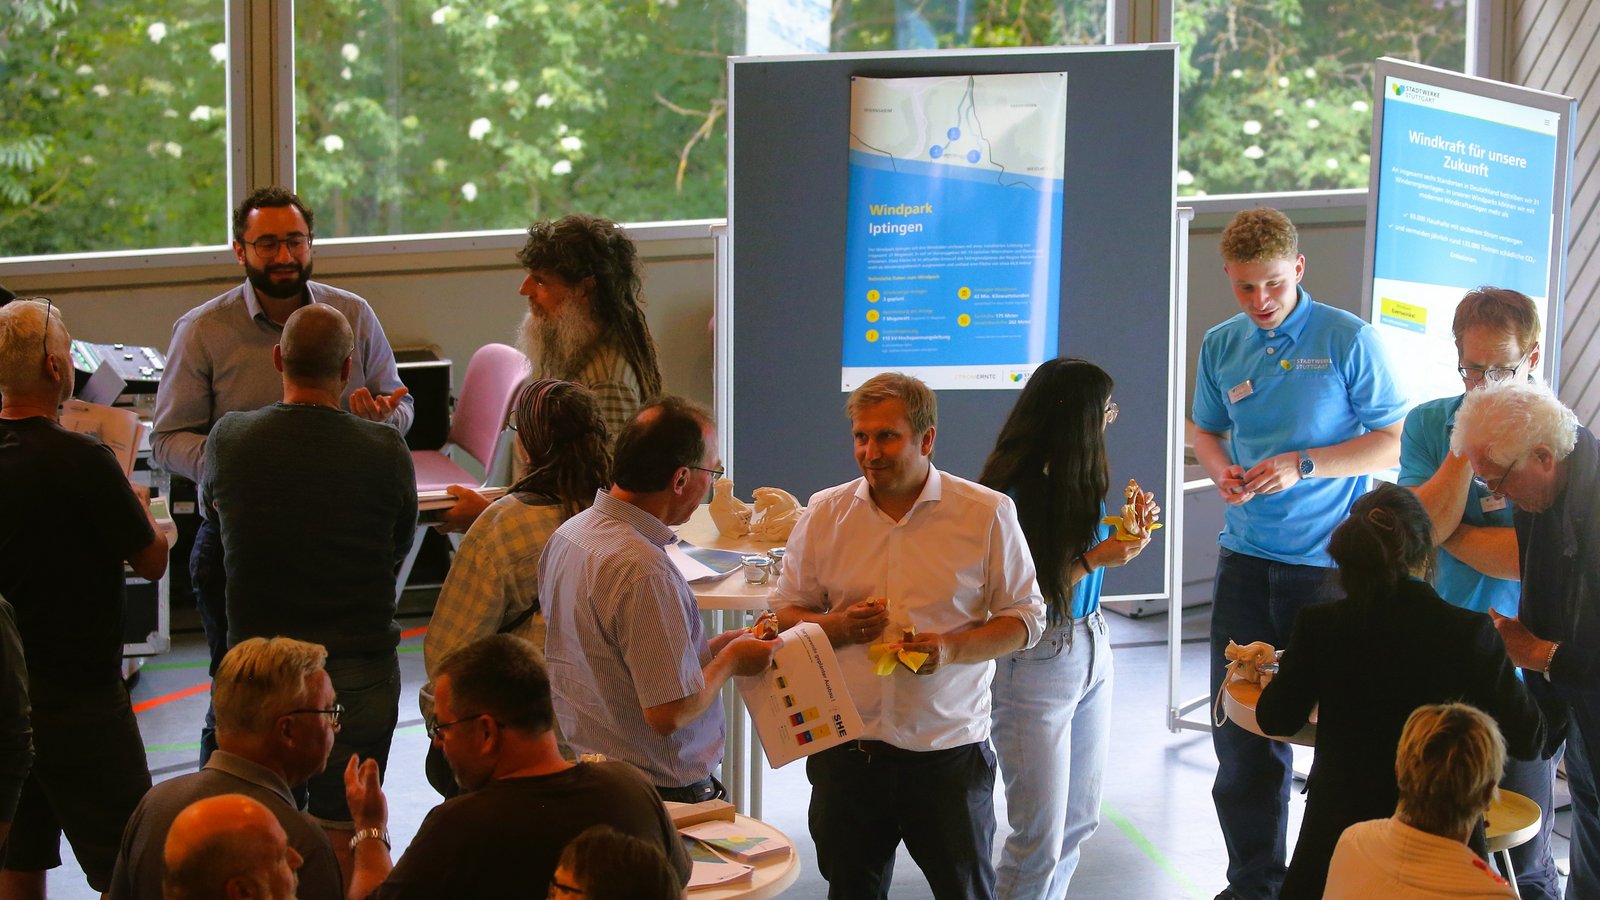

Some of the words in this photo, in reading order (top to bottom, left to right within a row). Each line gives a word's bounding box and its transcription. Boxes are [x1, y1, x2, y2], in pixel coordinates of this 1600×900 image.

[1406, 86, 1440, 98] STADTWERKE
[1406, 92, 1435, 103] STUTTGART
[1409, 129, 1466, 155] Windkraft
[1468, 143, 1486, 160] für
[1488, 150, 1527, 169] unsere
[1443, 155, 1489, 178] Zukunft
[869, 202, 933, 218] Windpark
[869, 221, 923, 237] Iptingen
[814, 654, 827, 678] geplanter
[824, 678, 834, 700] Ausbau
[833, 713, 848, 738] SHE
